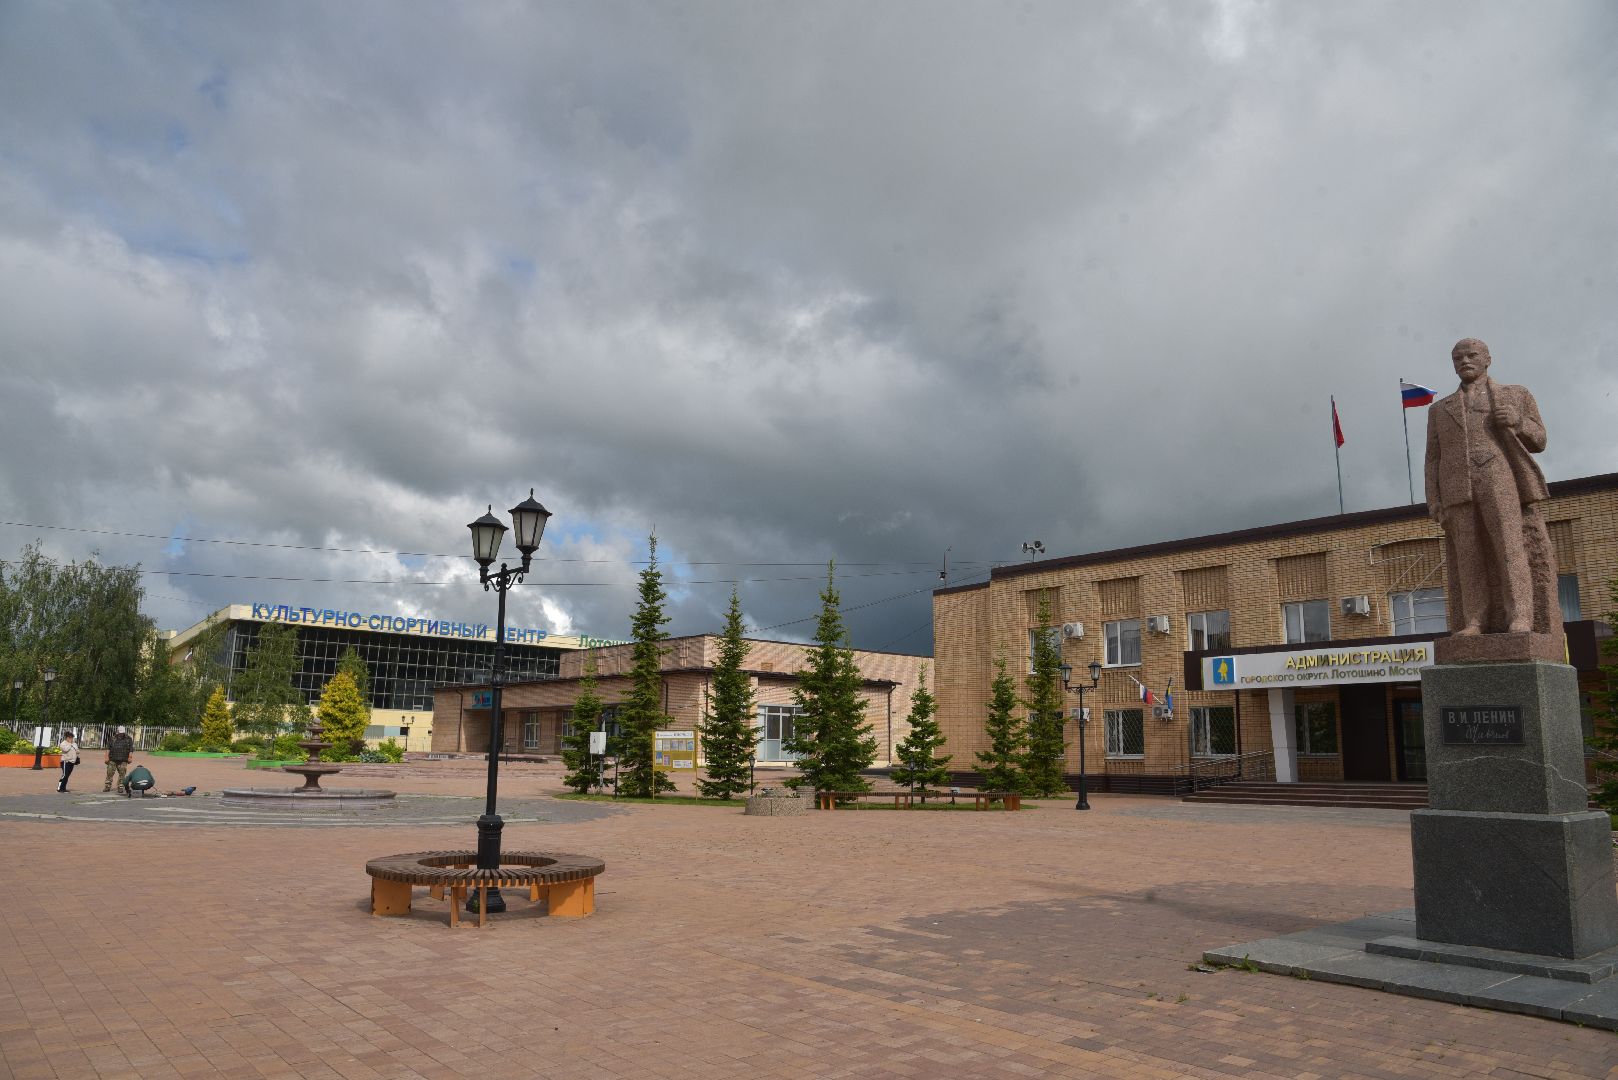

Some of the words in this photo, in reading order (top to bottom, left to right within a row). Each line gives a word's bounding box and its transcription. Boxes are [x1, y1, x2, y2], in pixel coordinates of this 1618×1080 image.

[252, 603, 487, 638] КУЛЬТУРНО-СПОРТИВНЫЙ
[1285, 648, 1427, 669] АДМИНИСТРАЦИЯ
[1473, 710, 1516, 724] ЛЕНИН
